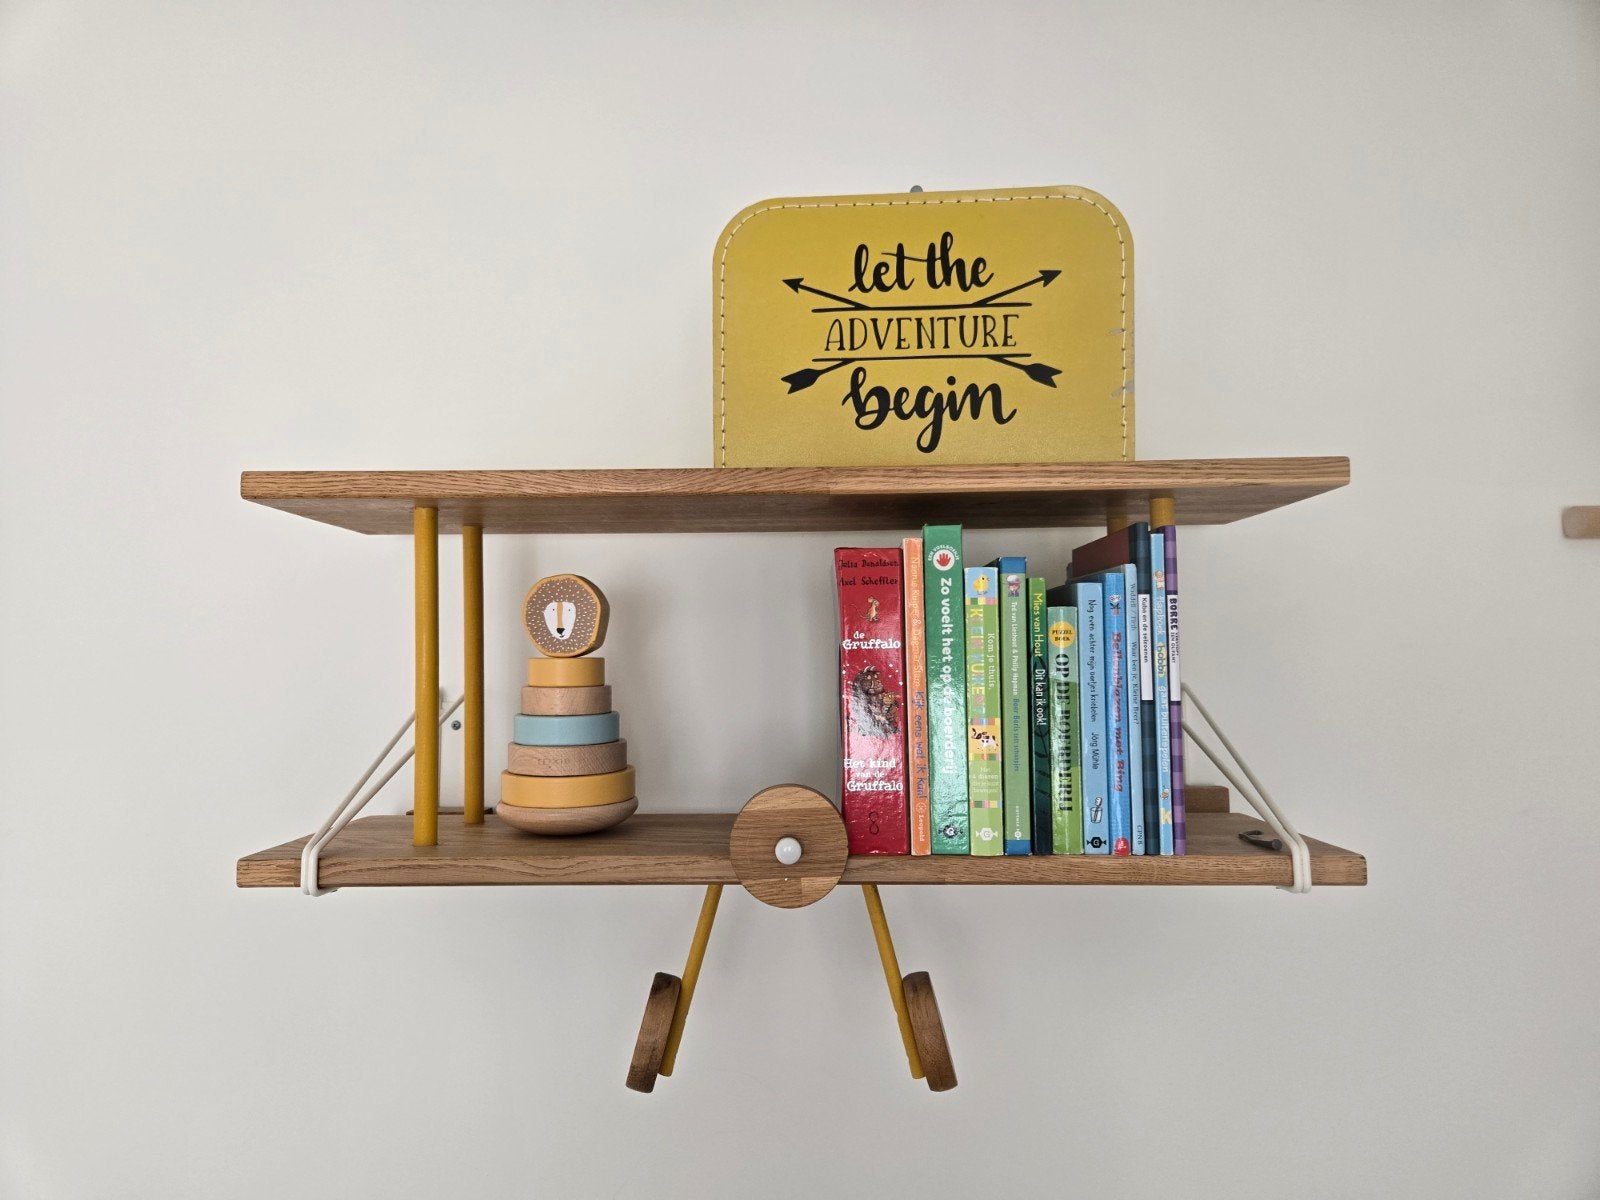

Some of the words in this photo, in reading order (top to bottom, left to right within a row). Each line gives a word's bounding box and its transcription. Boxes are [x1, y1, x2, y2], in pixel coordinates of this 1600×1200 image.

[848, 243, 915, 294] let
[923, 232, 994, 292] the
[825, 313, 1019, 352] ADVENTURE
[842, 366, 1017, 453] begin
[862, 559, 899, 567] Donaldson
[861, 576, 898, 586] Scheffler
[941, 578, 952, 596] Zo
[1034, 593, 1043, 616] Mies
[1087, 600, 1098, 613] Nog
[1130, 584, 1138, 608] Waddell
[941, 598, 954, 635] voelt
[1142, 614, 1147, 623] en
[1154, 596, 1166, 635] flapboek
[1170, 598, 1179, 630] BORRE
[853, 631, 864, 639] de
[1142, 624, 1149, 632] de
[842, 639, 901, 650] Gruffalo
[911, 629, 922, 663] Dagmar
[942, 637, 954, 663] het
[988, 633, 996, 652] Kom
[1034, 634, 1044, 657] Hout
[1089, 633, 1097, 654] achter
[986, 654, 995, 663] je
[1056, 654, 1070, 678] OP
[1087, 656, 1096, 671] mijn
[913, 666, 923, 687] Stam
[940, 665, 951, 684] op
[1035, 669, 1045, 680] Dit
[1088, 672, 1097, 693] oortjes
[1112, 632, 1123, 723] Bellenblazen
[943, 687, 955, 705] de
[1036, 682, 1045, 696] kan
[1056, 681, 1071, 705] DE
[1159, 686, 1168, 709] gaat
[912, 692, 926, 710] Kijk
[1036, 698, 1046, 706] ik
[1090, 694, 1099, 723] kriebelen
[914, 715, 923, 738] eens
[1036, 708, 1046, 726] ook!
[916, 741, 925, 759] wat
[941, 707, 956, 775] boerderij
[1090, 732, 1101, 747] Jörg
[1115, 726, 1124, 756] met
[1160, 711, 1170, 773] buitenspelen
[844, 758, 865, 768] Het
[869, 758, 896, 768] kind
[1057, 710, 1073, 812] BOERDERIJ
[1092, 748, 1102, 770] Mühle
[847, 780, 903, 791] Gruffalo
[1113, 759, 1125, 792] Bing
